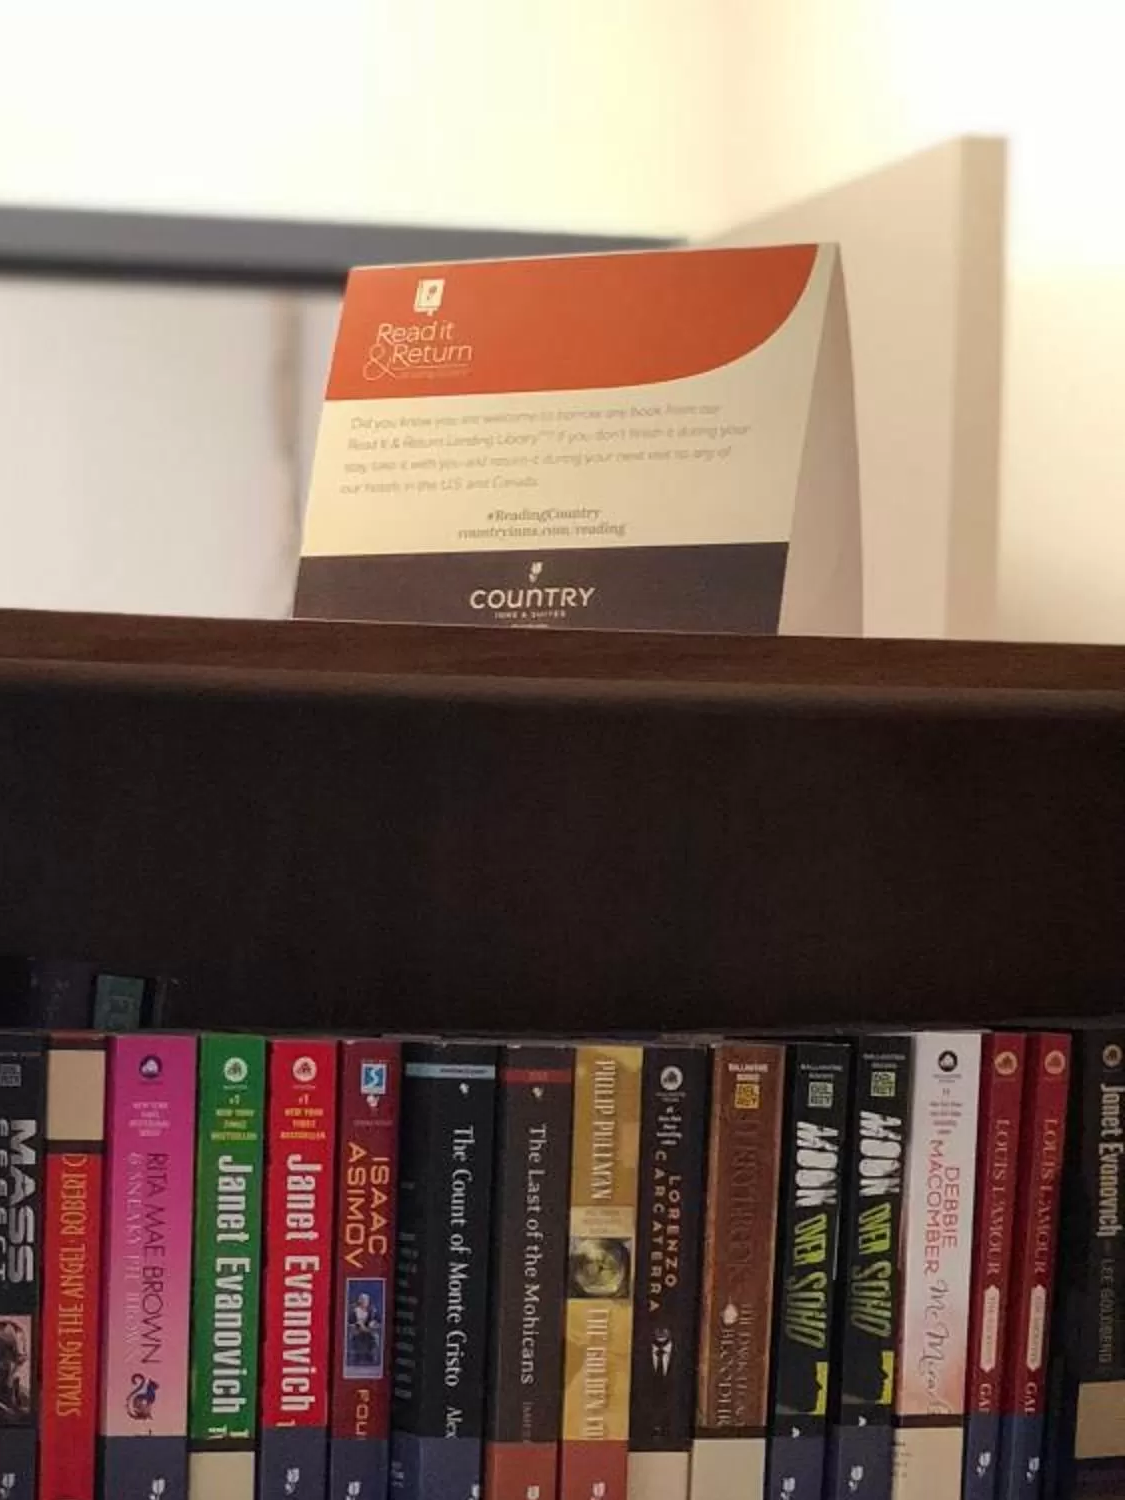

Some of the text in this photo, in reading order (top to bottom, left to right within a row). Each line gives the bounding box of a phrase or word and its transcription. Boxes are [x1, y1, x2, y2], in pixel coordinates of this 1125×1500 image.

[362, 343, 473, 381] & Return
[376, 321, 455, 346] Read it
[451, 1124, 476, 1163] The
[527, 1123, 547, 1164] The
[589, 1058, 617, 1200] PHILIP PULLMAN
[795, 1119, 840, 1208] MOON
[858, 1110, 903, 1197] MOON
[992, 1117, 1012, 1181] LOUIS
[1039, 1118, 1059, 1182] LOUIS
[1095, 1082, 1124, 1238] Janet Evanovich
[8, 1117, 37, 1284] MASS
[146, 1151, 172, 1198] RITA
[343, 1140, 368, 1270] ASIMOV
[367, 1156, 392, 1257] ISAAC
[449, 1167, 475, 1226] Count
[525, 1167, 546, 1214] Last
[922, 1138, 945, 1277] MACOMBER
[941, 1165, 962, 1249] DEBBIE
[143, 1203, 166, 1259] MAE
[448, 1232, 471, 1254] of
[523, 1242, 544, 1278] the
[525, 1218, 545, 1240] of
[647, 1150, 668, 1313] CARCATERRA
[663, 1173, 683, 1289] LORENZO
[792, 1212, 828, 1267] OVER
[858, 1202, 892, 1255] OVER
[55, 1172, 88, 1419] STALKING THE ANGEL ROBERT
[139, 1264, 165, 1365] BROWN
[210, 1153, 255, 1415] Janet Evanovich
[279, 1152, 324, 1412] Janet Evanovich
[446, 1259, 471, 1325] Monte
[783, 1270, 828, 1350] SOHO
[849, 1259, 892, 1338] SOHO
[443, 1328, 468, 1388] Cristo
[519, 1282, 542, 1385] Mohicans
[581, 1307, 610, 1413] THE GOLDEN
[354, 1387, 372, 1439] FOU
